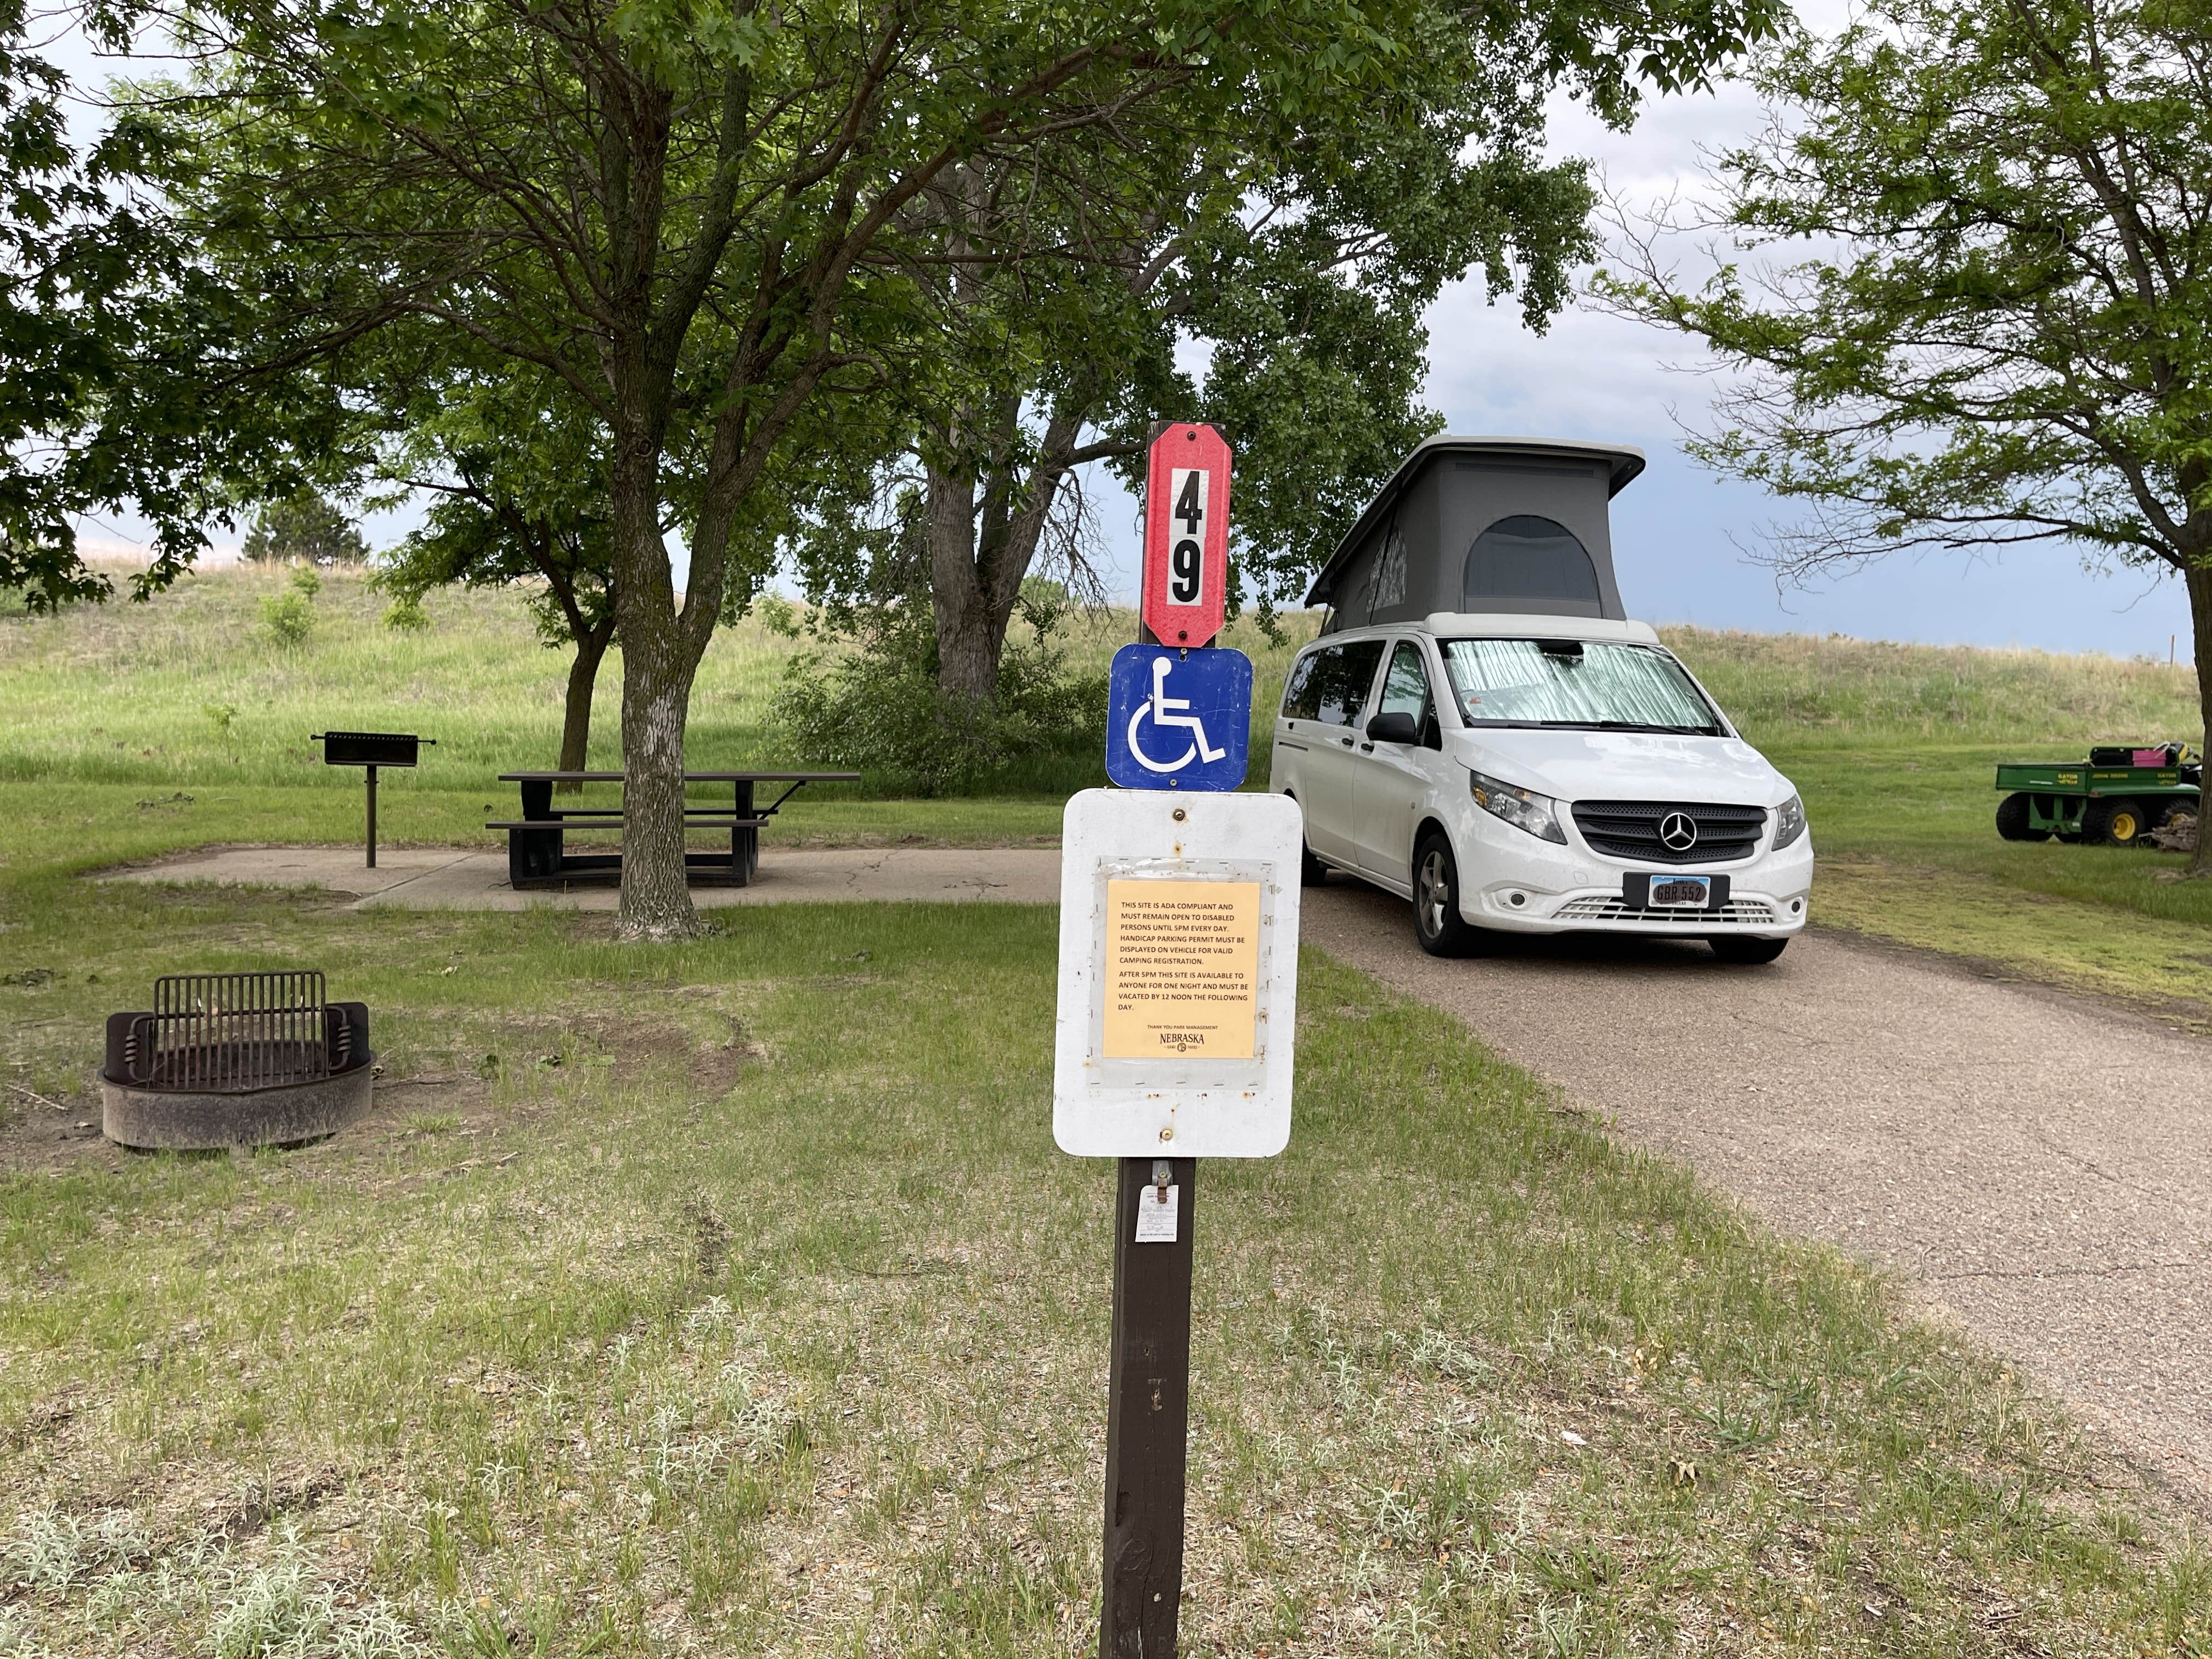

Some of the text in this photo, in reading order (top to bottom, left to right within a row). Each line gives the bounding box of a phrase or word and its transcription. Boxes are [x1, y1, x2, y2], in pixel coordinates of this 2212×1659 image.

[1172, 471, 1202, 603] 49
[1657, 885, 1701, 901] GBR 552
[1153, 957, 1204, 965] REGISTRATION.
[1119, 970, 1140, 978] AFTER
[1158, 970, 1173, 979] THIS
[1189, 971, 1196, 979] IS
[1197, 972, 1233, 980] AVAILABLE
[1118, 981, 1148, 989] ANYONE
[1148, 981, 1163, 990] FOR
[1180, 982, 1201, 990] NIGHT
[1218, 983, 1239, 991] MUST
[1118, 992, 1150, 1000] VACATED
[1207, 994, 1248, 1002] FOLLOWING
[1160, 1034, 1204, 1044] NEBRASKA
